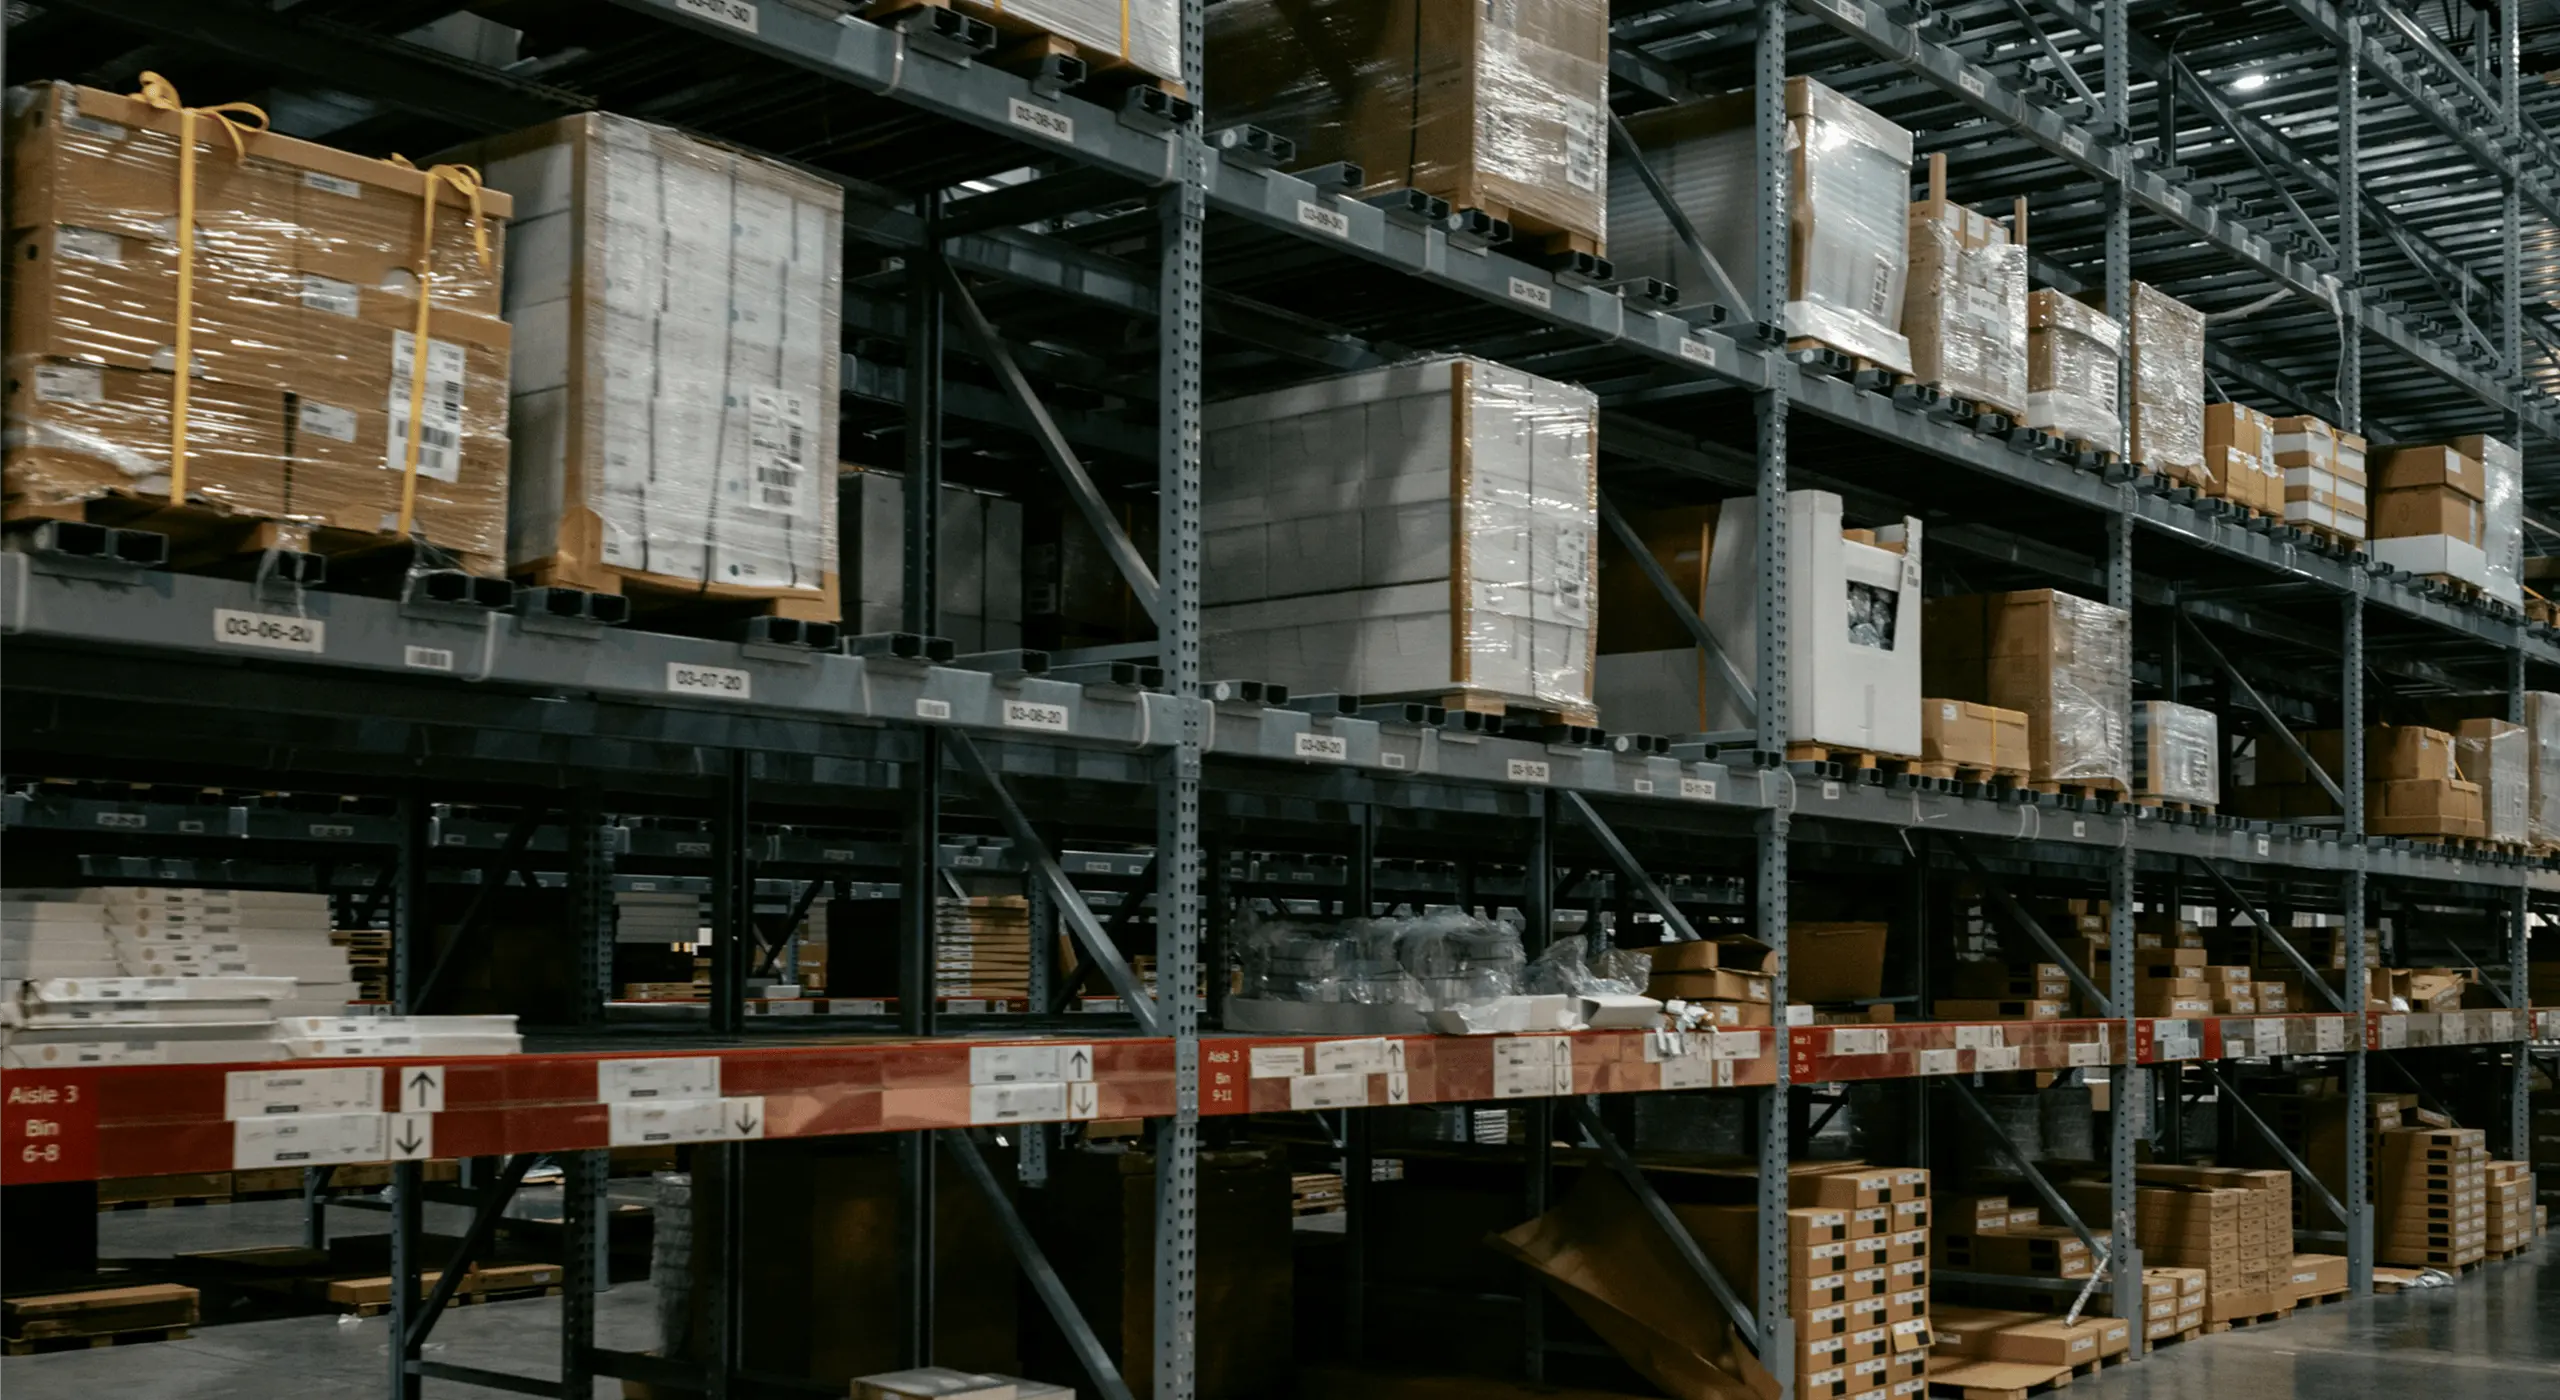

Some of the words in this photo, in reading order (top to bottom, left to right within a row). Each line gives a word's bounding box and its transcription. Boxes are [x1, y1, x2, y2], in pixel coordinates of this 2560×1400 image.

[226, 617, 313, 643] 03-06-20
[676, 670, 742, 690] 03-07-20
[1231, 1050, 1239, 1063] 3
[7, 1085, 60, 1104] Aisle
[63, 1085, 79, 1103] 3
[26, 1119, 60, 1136] Bin
[23, 1144, 60, 1162] 6-8
